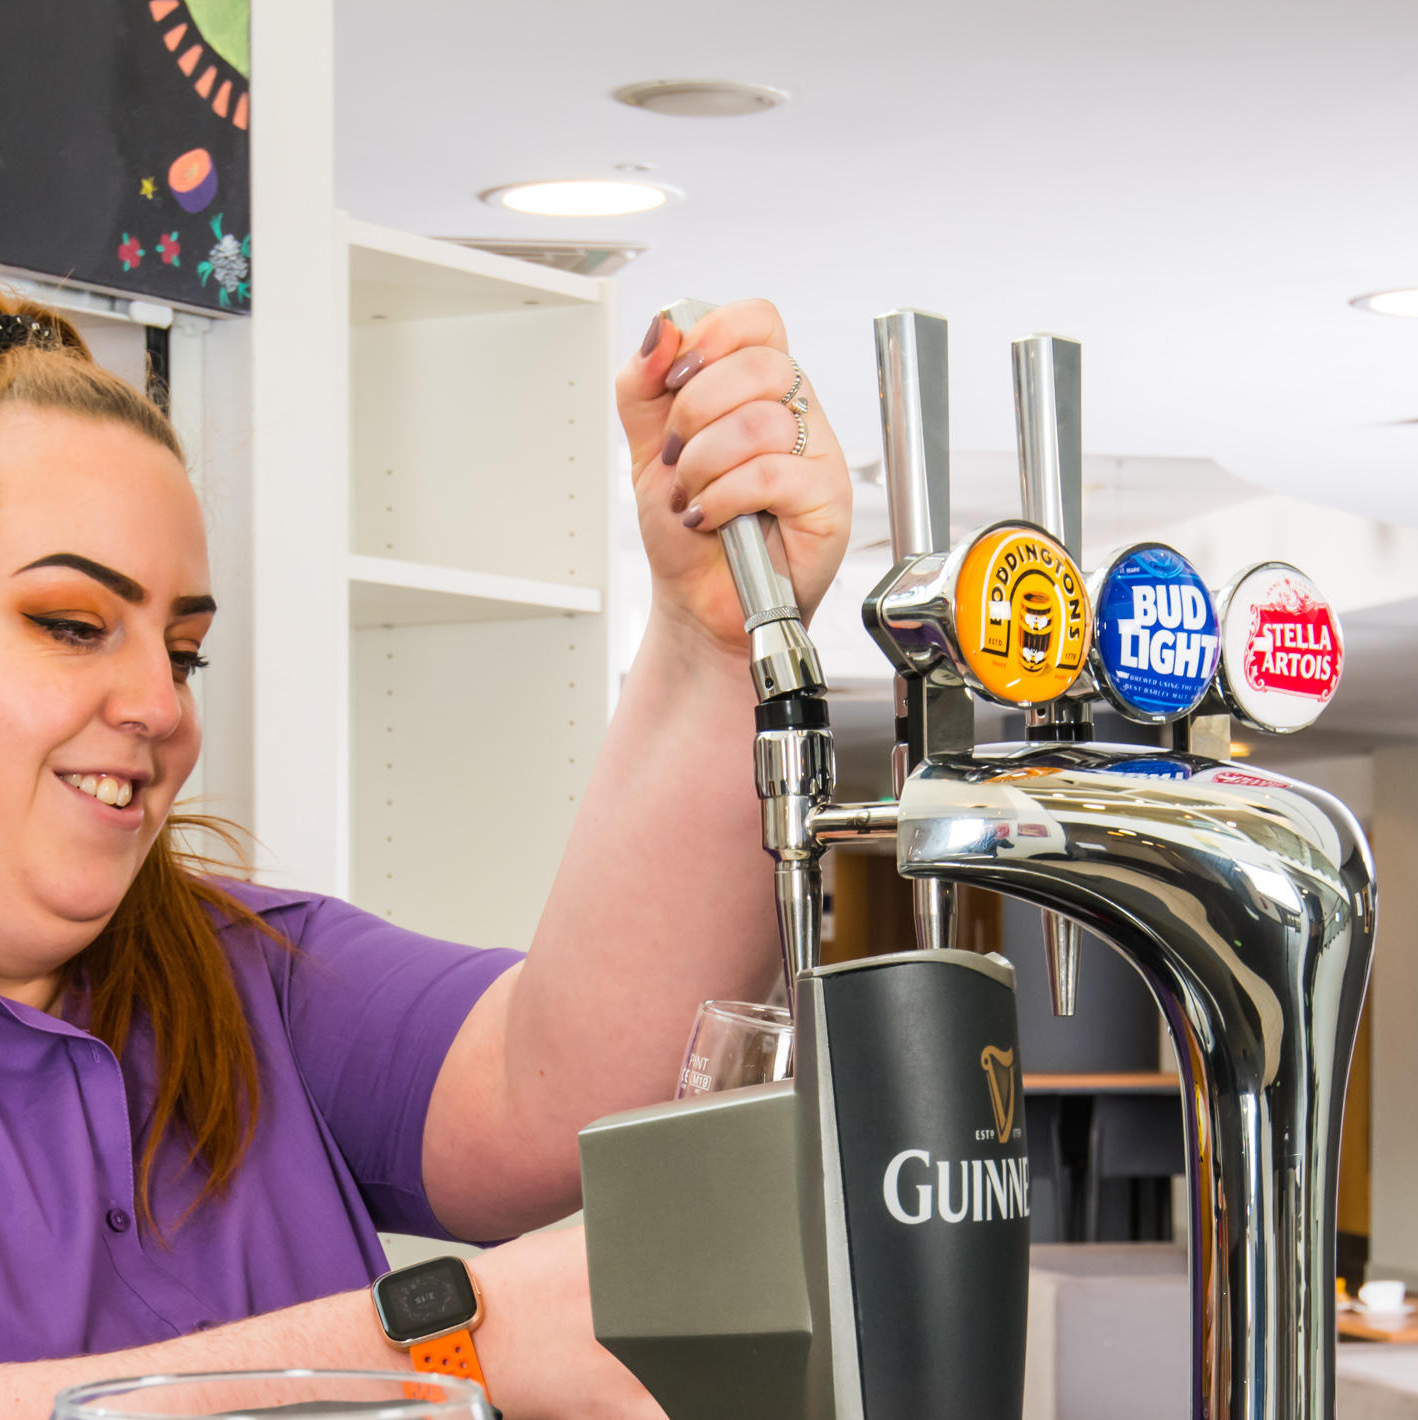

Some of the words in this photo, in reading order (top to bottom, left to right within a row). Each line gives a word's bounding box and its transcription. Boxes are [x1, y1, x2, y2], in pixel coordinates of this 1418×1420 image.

[1132, 584, 1207, 630] BUD
[1117, 622, 1218, 680] LIGHT
[1262, 623, 1332, 651] STELLA
[1261, 650, 1331, 681] ARTOIS
[883, 1149, 1030, 1225] GUINNE
